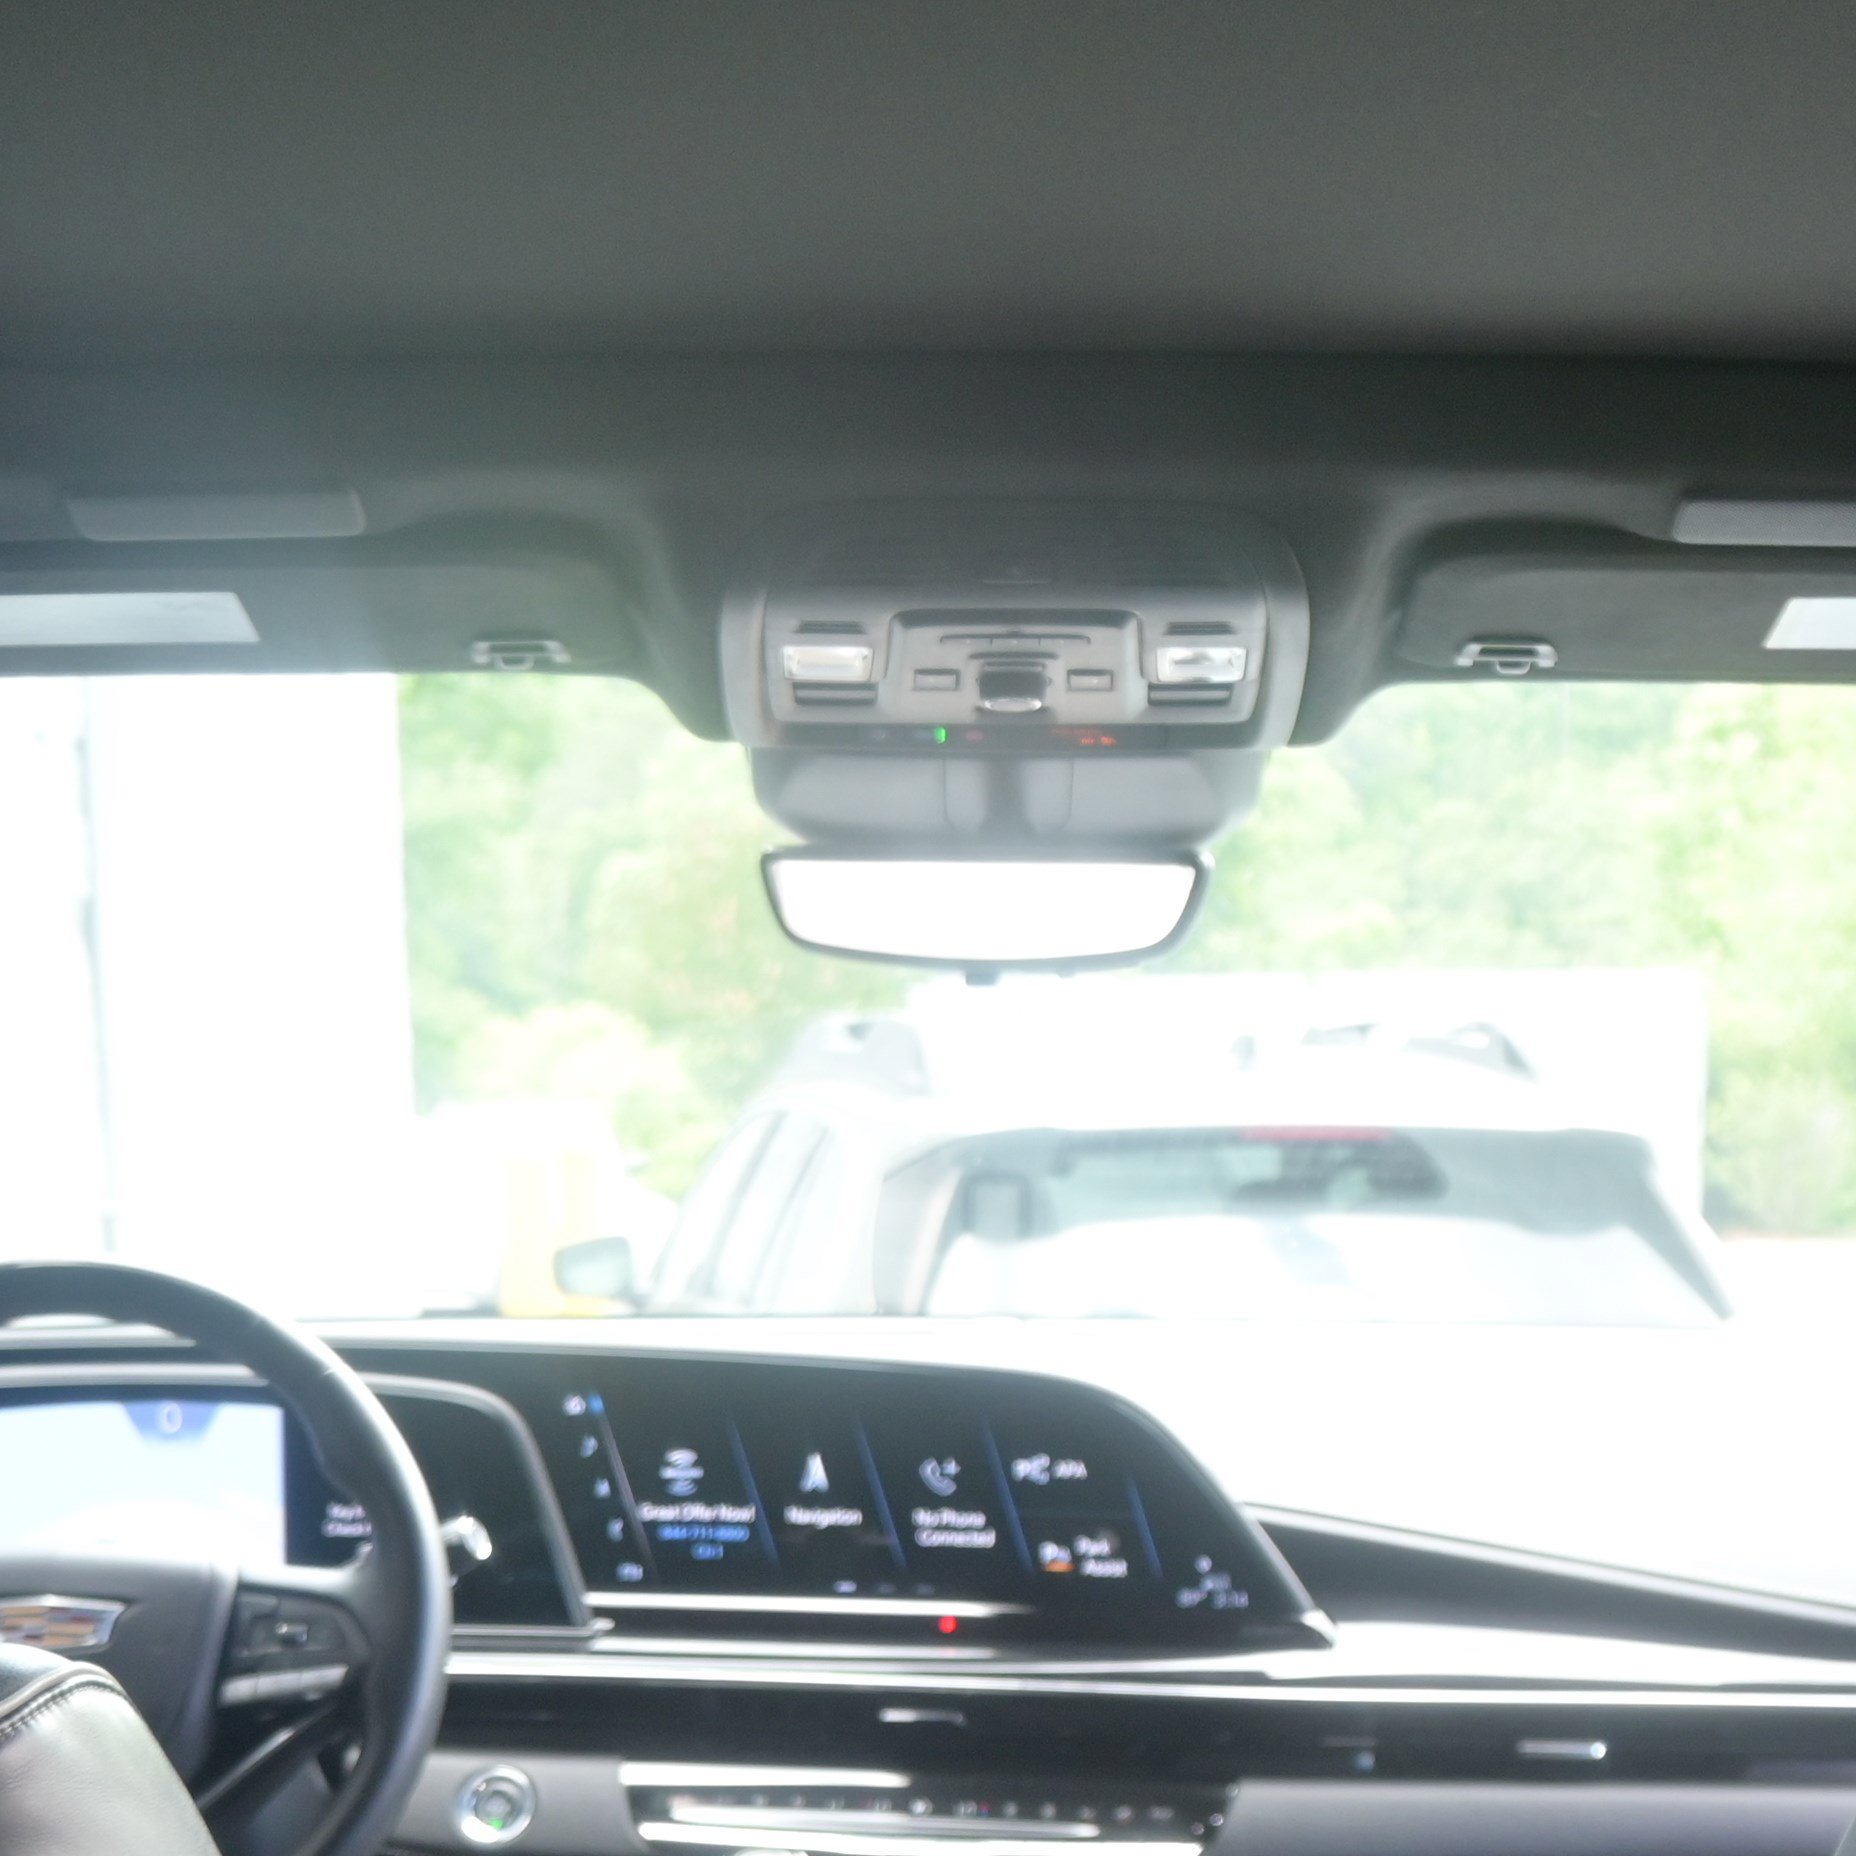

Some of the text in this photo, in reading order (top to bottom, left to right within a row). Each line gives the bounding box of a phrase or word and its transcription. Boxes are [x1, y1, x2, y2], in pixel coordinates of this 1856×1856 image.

[638, 1502, 679, 1522] Great
[681, 1502, 717, 1522] Offer
[784, 1504, 863, 1530] Navigation
[912, 1506, 986, 1529] No Phone
[914, 1526, 996, 1549] Connected
